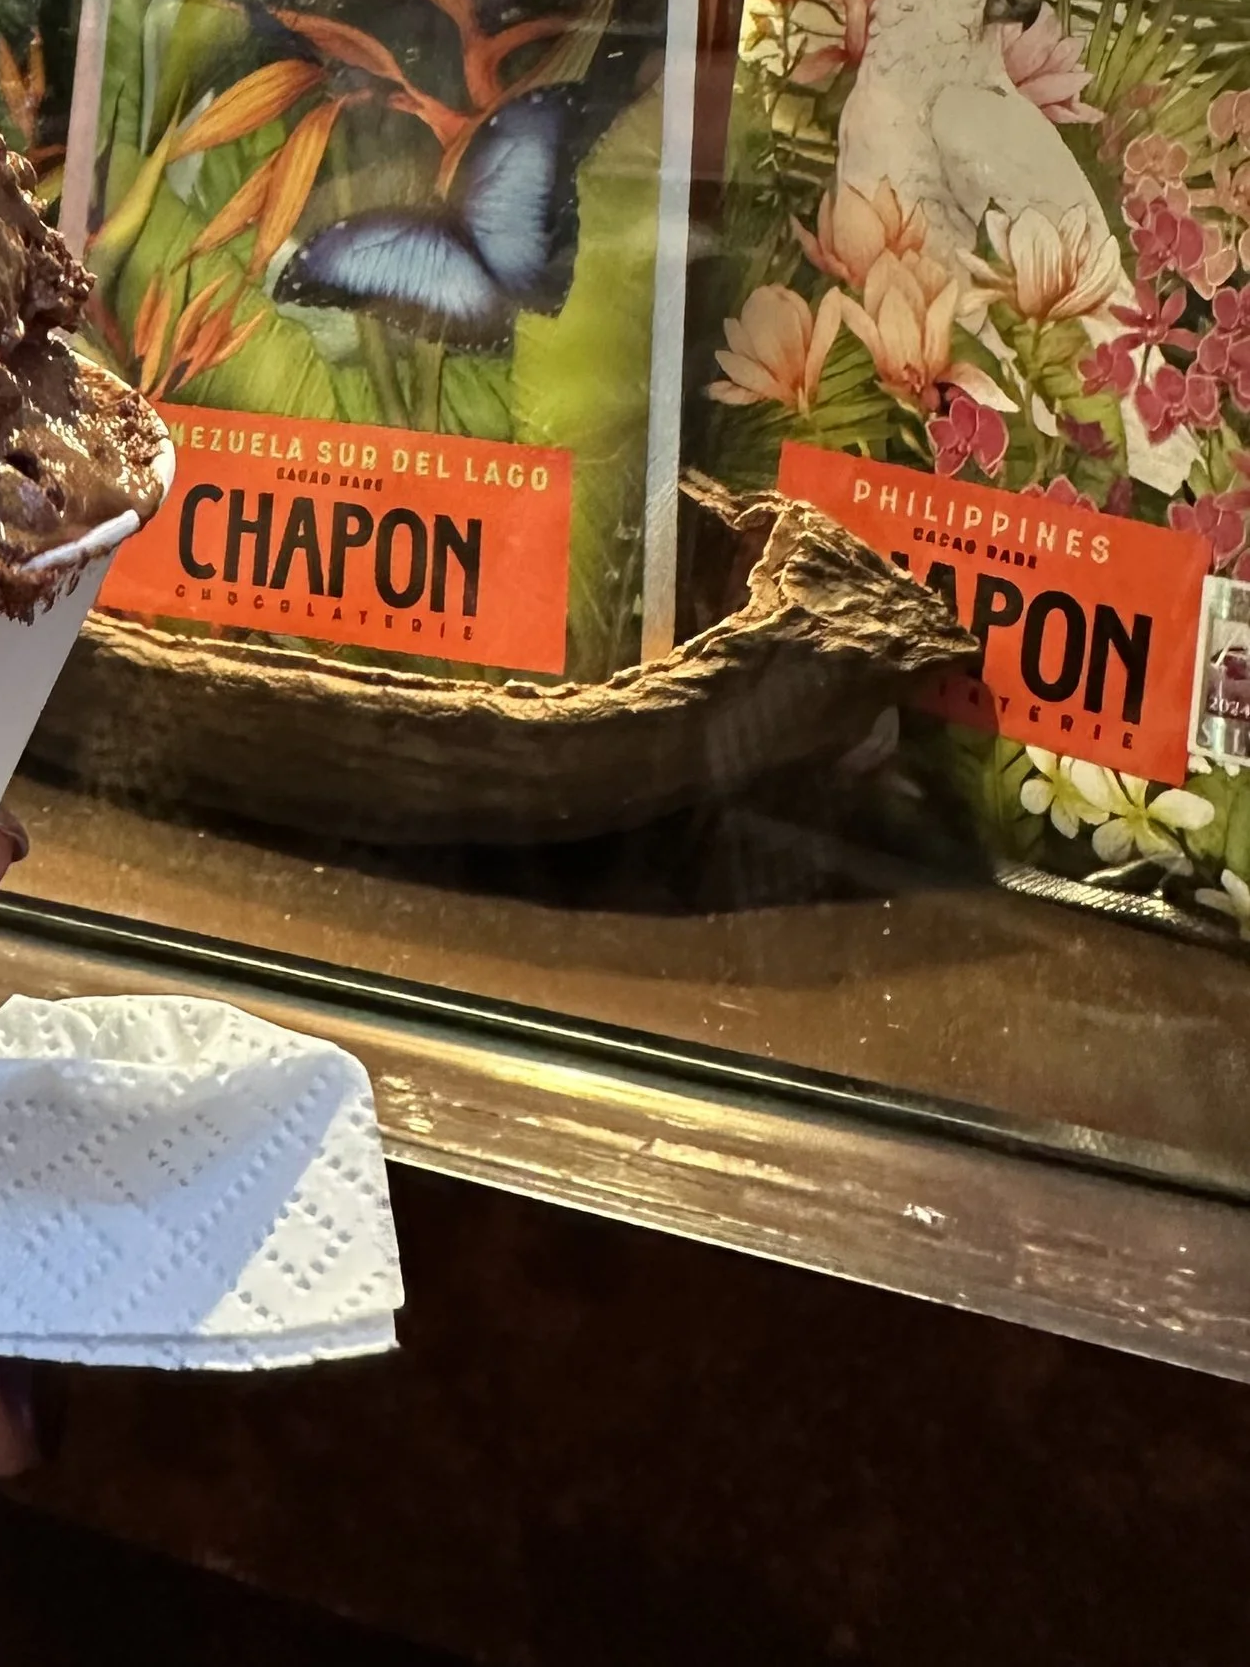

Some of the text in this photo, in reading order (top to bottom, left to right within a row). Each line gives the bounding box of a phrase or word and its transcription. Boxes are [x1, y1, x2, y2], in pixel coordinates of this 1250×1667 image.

[317, 440, 377, 470] SUR
[392, 449, 450, 479] DEL
[465, 457, 548, 491] LAGO
[179, 484, 482, 616] CHAPON
[853, 479, 1110, 564] PHILIPPINES
[913, 527, 977, 554] CACAO
